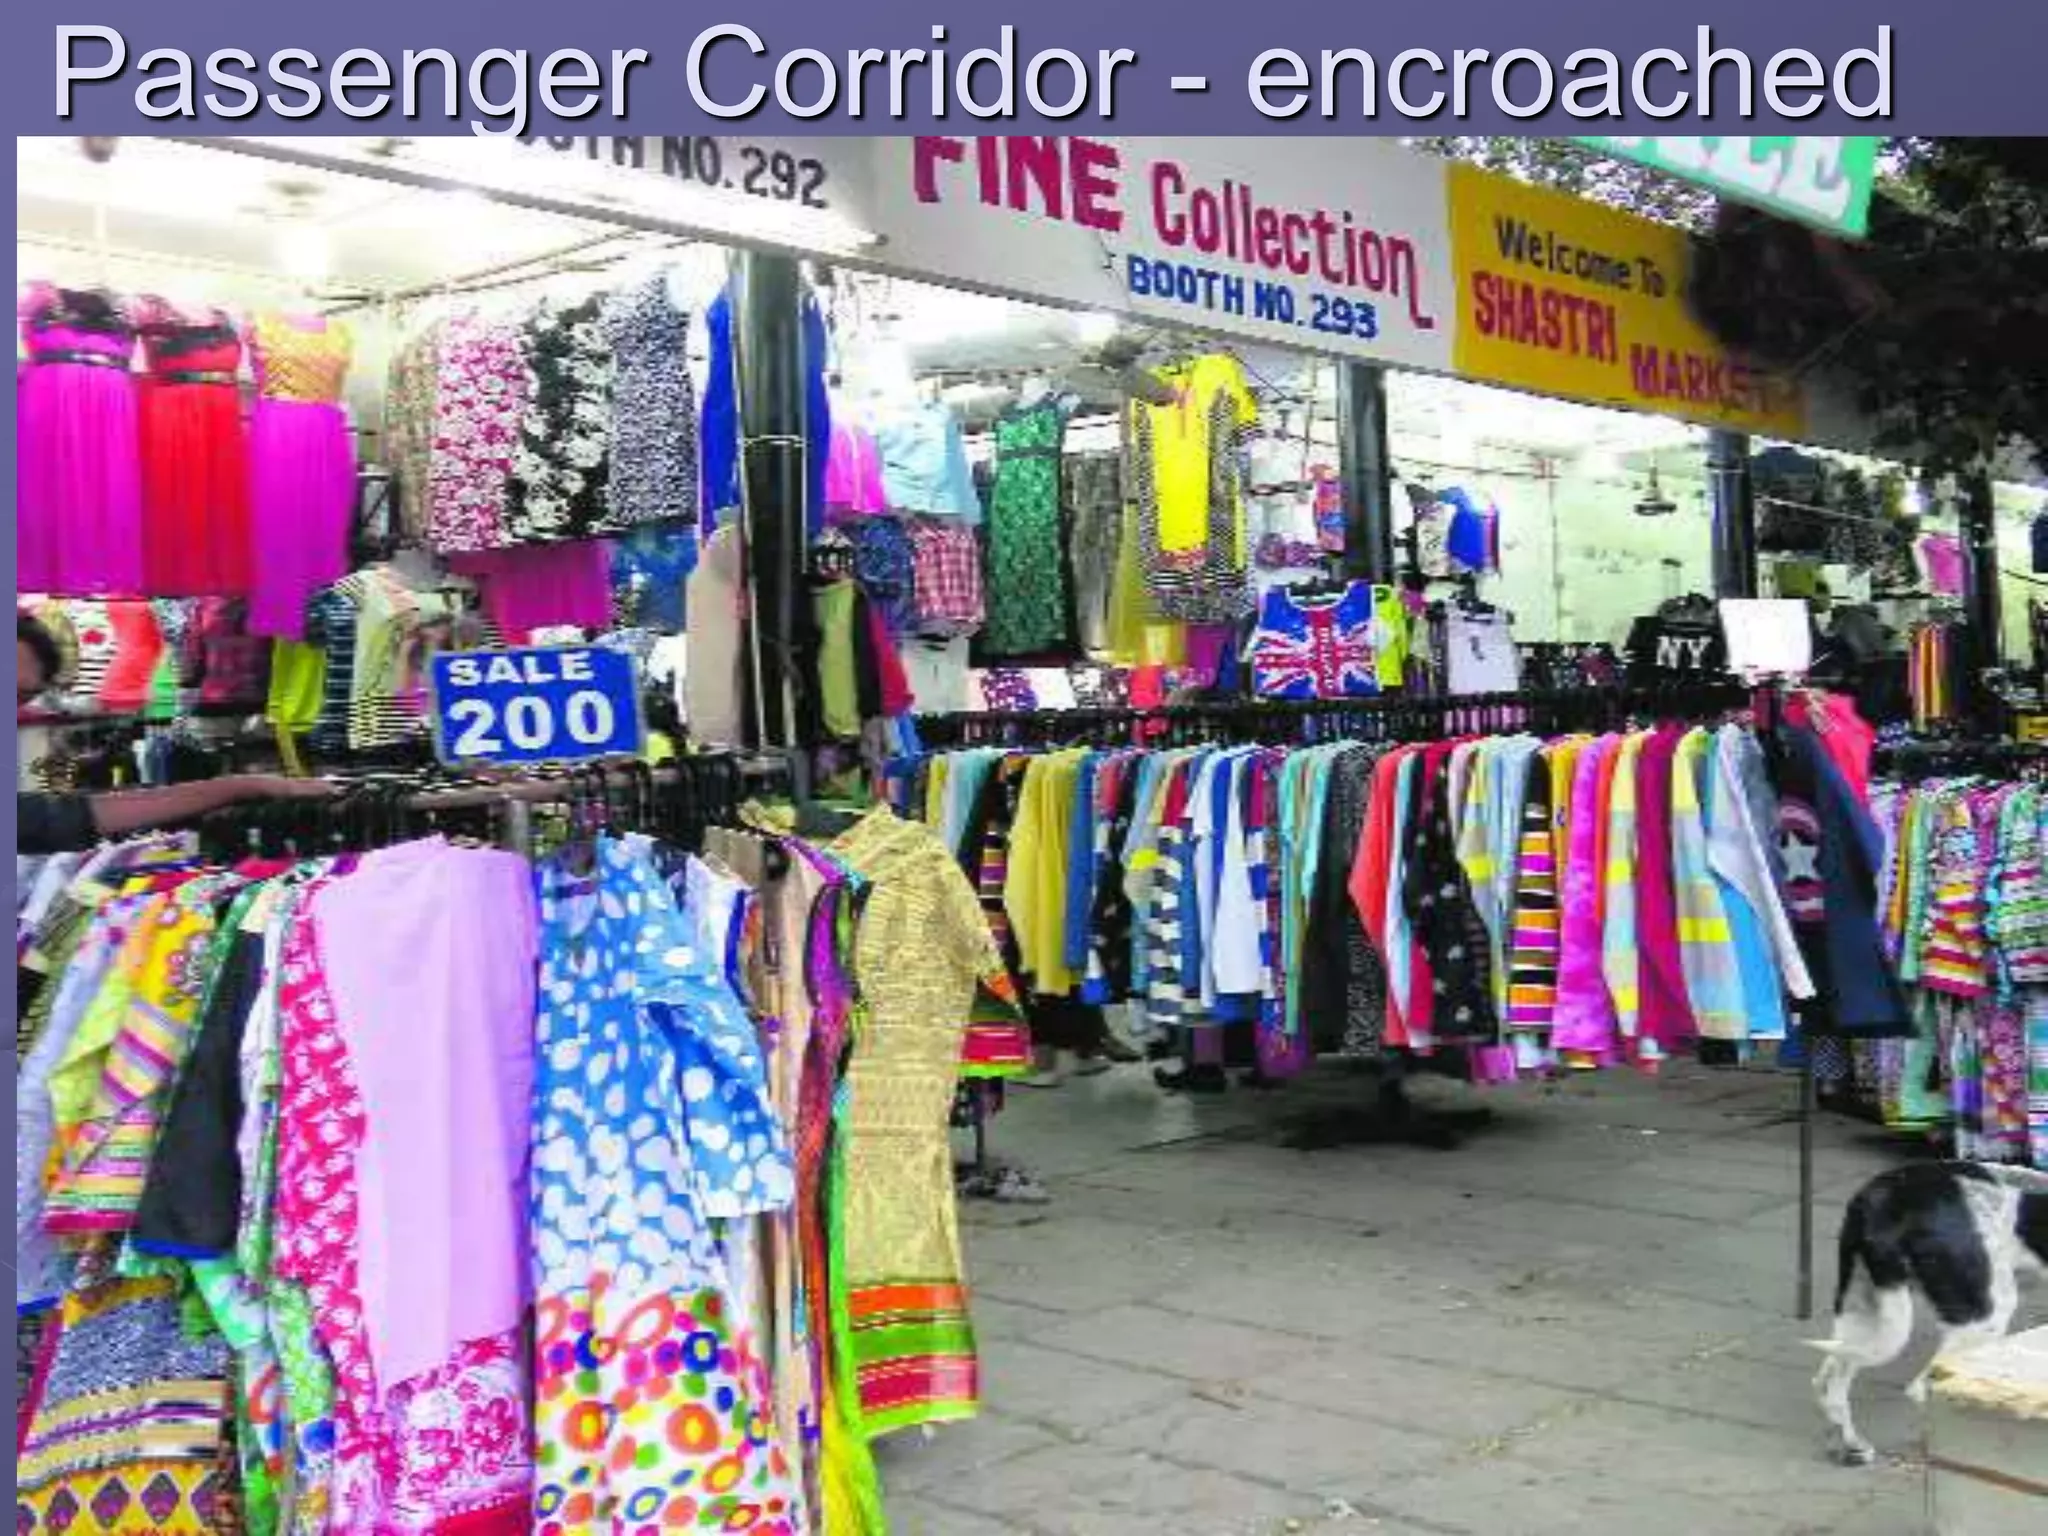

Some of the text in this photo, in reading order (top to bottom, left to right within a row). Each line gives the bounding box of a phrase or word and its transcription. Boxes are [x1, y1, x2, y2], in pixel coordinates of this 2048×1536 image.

[913, 136, 1434, 330] FINE Collection
[1495, 214, 1666, 299] Welcome To
[1127, 253, 1244, 316] BOOTH
[1471, 271, 1618, 364] SHASTRI
[446, 651, 595, 686] SALE
[1655, 635, 1712, 669] NY
[448, 690, 615, 756] 200
